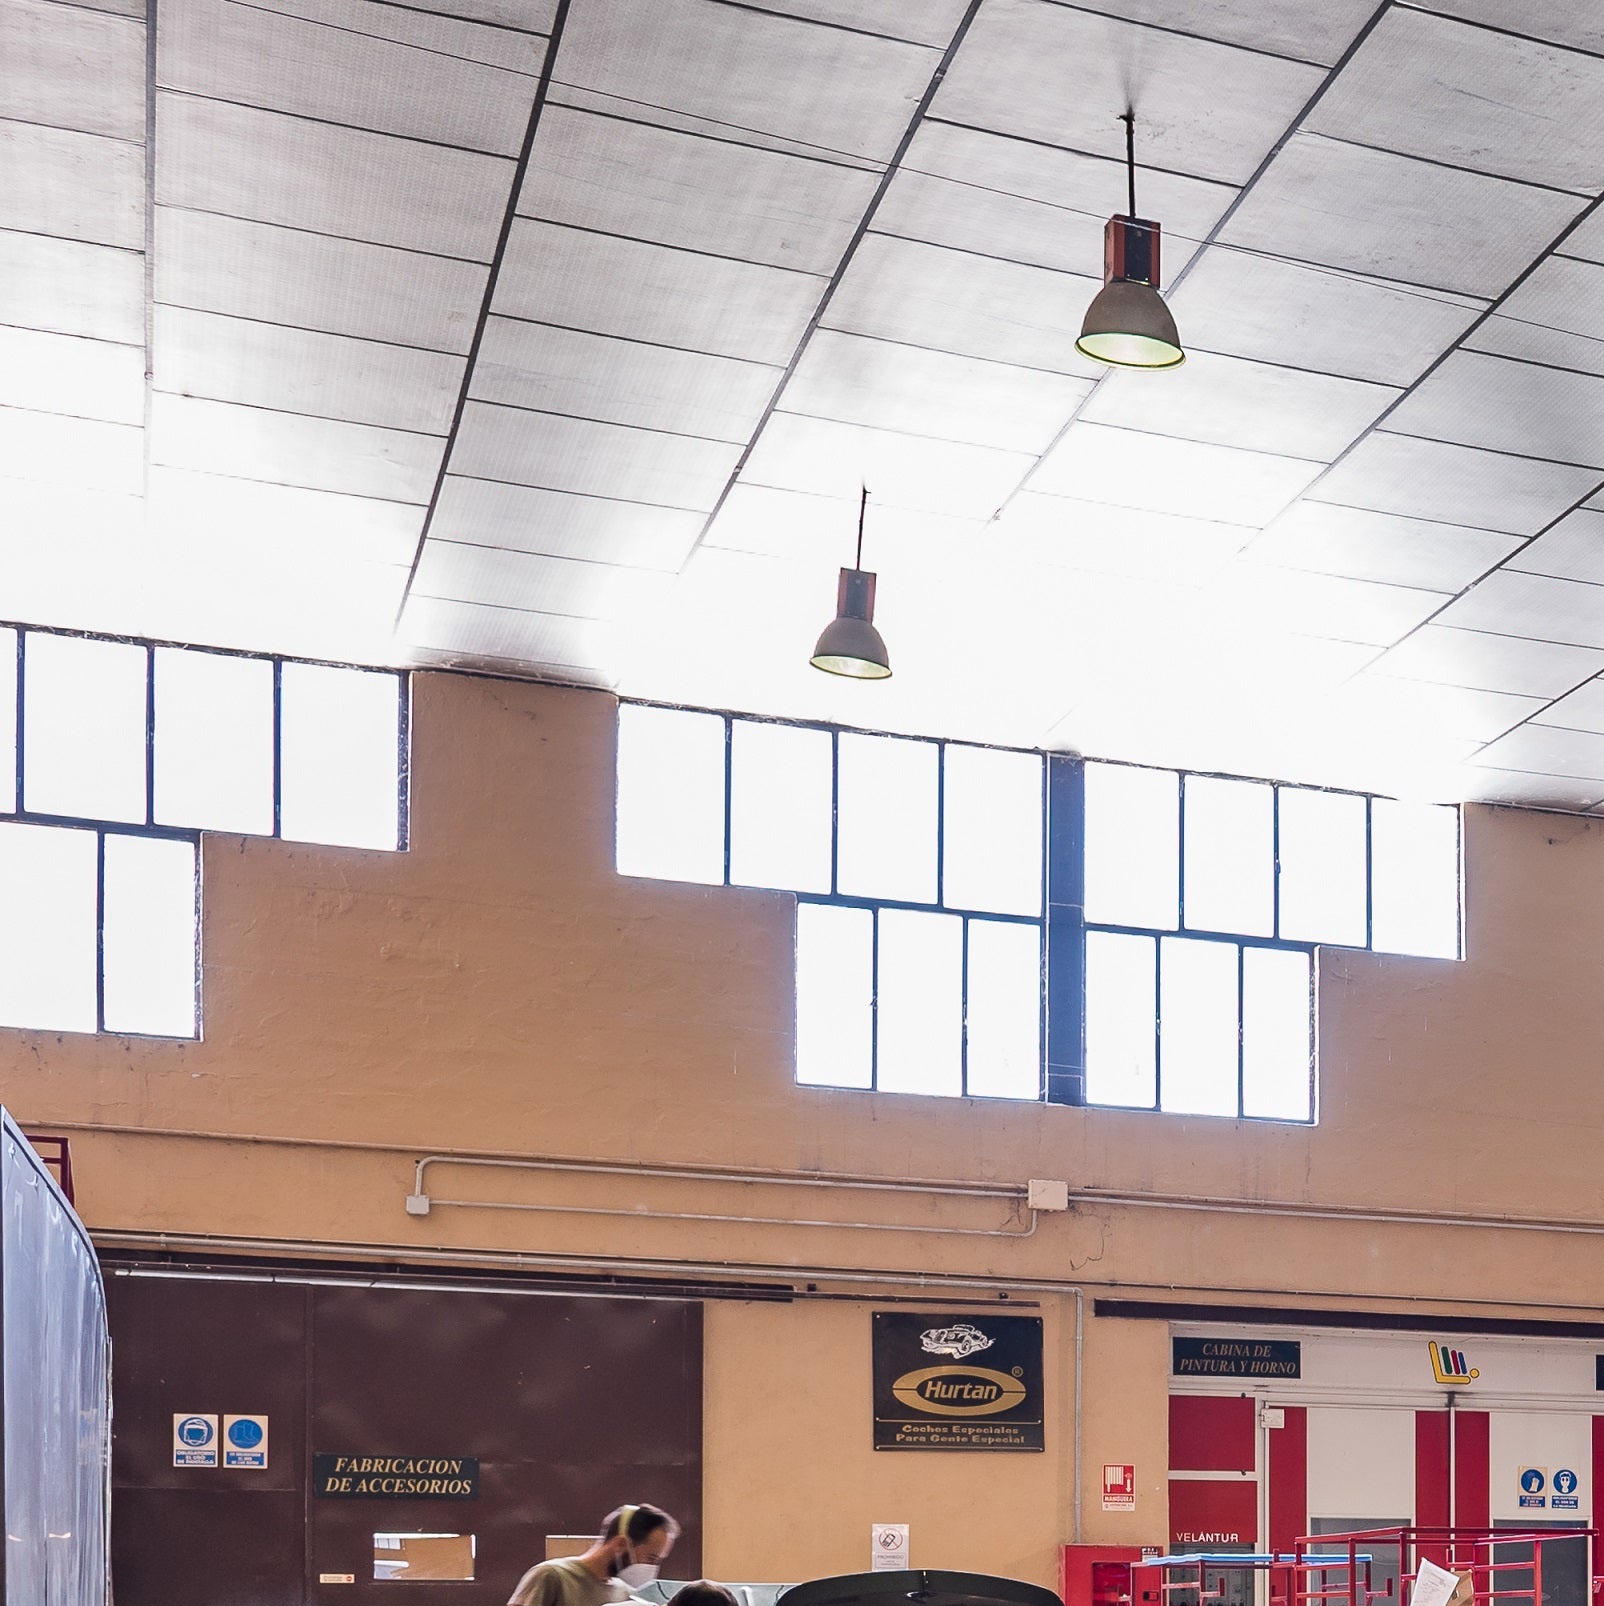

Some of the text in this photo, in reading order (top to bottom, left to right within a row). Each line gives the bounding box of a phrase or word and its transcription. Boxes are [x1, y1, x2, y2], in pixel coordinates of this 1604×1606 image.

[1202, 1343, 1272, 1357] CABINA DE
[1180, 1359, 1296, 1374] PINTURA Y HORNO
[924, 1381, 998, 1400] Hurtan
[902, 1424, 1019, 1435] Coches Especiales
[896, 1434, 1025, 1444] Para Gente Especial
[334, 1458, 463, 1475] FABRICACION
[325, 1477, 472, 1494] DE ACCESORIOS
